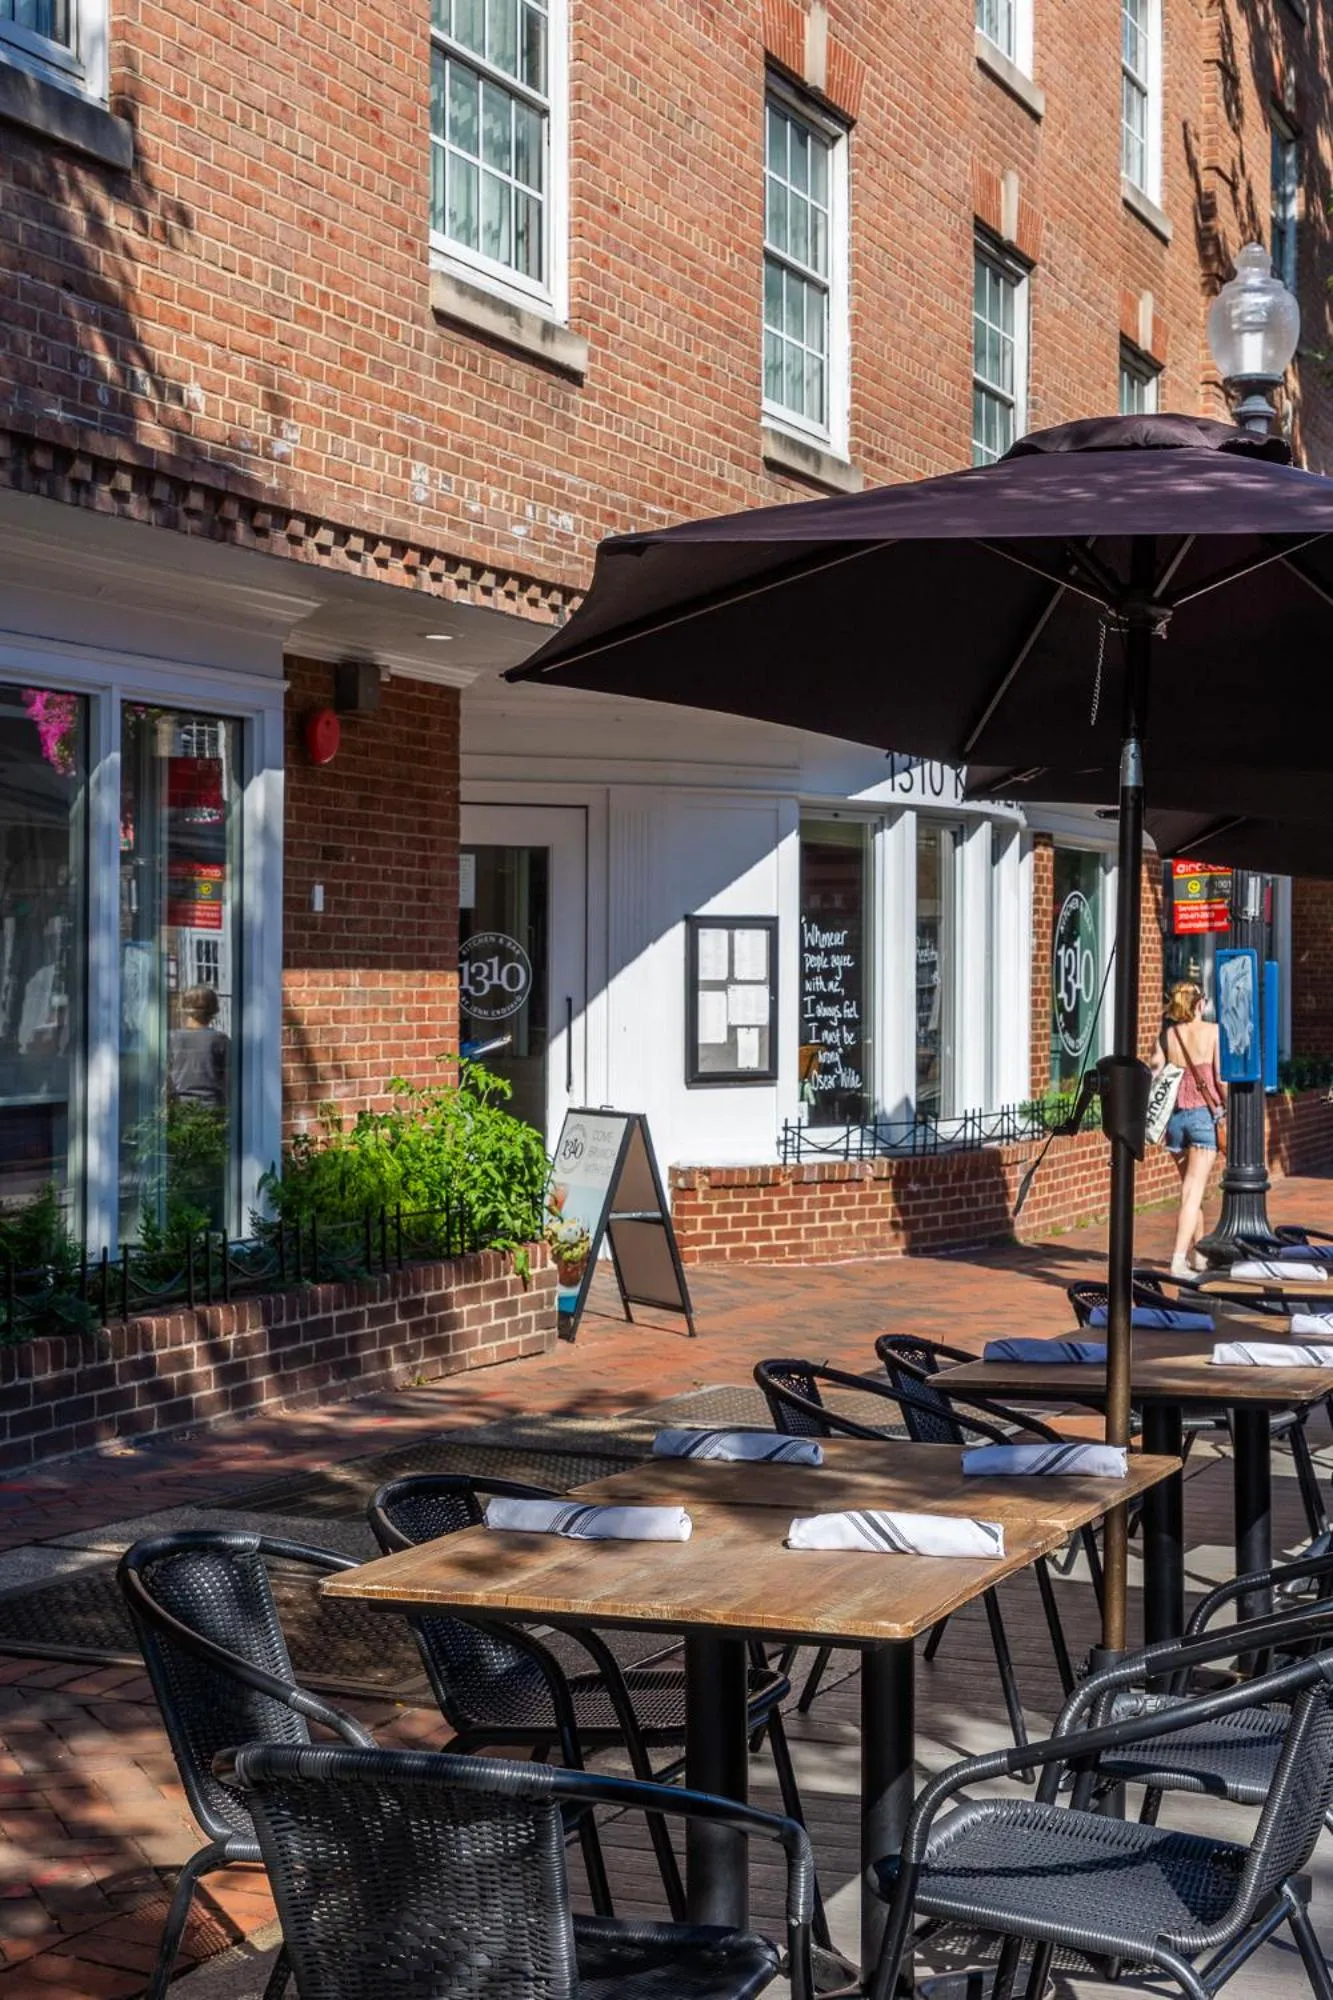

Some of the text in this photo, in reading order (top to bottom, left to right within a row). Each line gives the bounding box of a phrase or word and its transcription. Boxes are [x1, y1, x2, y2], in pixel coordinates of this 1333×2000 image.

[885, 751, 944, 796] 1310
[458, 956, 526, 996] 1310
[805, 975, 827, 992] with
[1057, 935, 1094, 1012] 1310
[803, 995, 816, 1018] I
[808, 1022, 820, 1043] I
[843, 1024, 856, 1045] be
